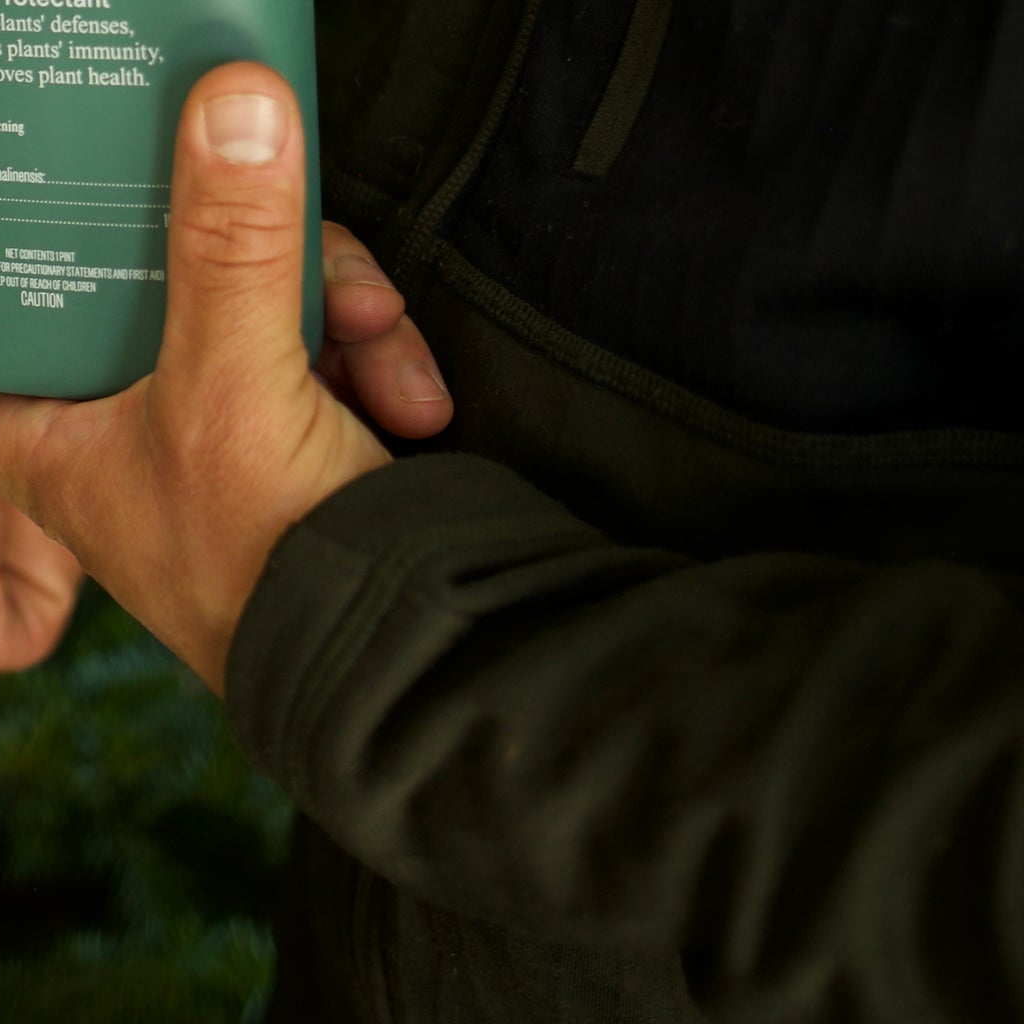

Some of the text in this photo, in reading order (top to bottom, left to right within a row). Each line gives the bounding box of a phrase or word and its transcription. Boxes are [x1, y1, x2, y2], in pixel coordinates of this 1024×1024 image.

[50, 15, 135, 37] defenses,
[7, 39, 63, 61] plants'
[68, 41, 165, 66] immunity,
[38, 65, 83, 88] plant
[88, 67, 150, 87] health.
[5, 248, 19, 259] NET
[19, 249, 55, 262] CONTENTS
[59, 251, 75, 263] PINT
[11, 262, 66, 276] PRECAUTIONARY
[65, 265, 112, 280] STATEMENTS
[112, 268, 128, 280] AND
[128, 269, 148, 281] FIRST
[148, 270, 165, 282] AID)
[6, 276, 19, 287] OUT
[19, 277, 29, 288] OF
[29, 277, 52, 290] REACH
[52, 279, 61, 290] OF
[62, 280, 96, 293] CHILDREN
[20, 290, 64, 309] CAUTION
